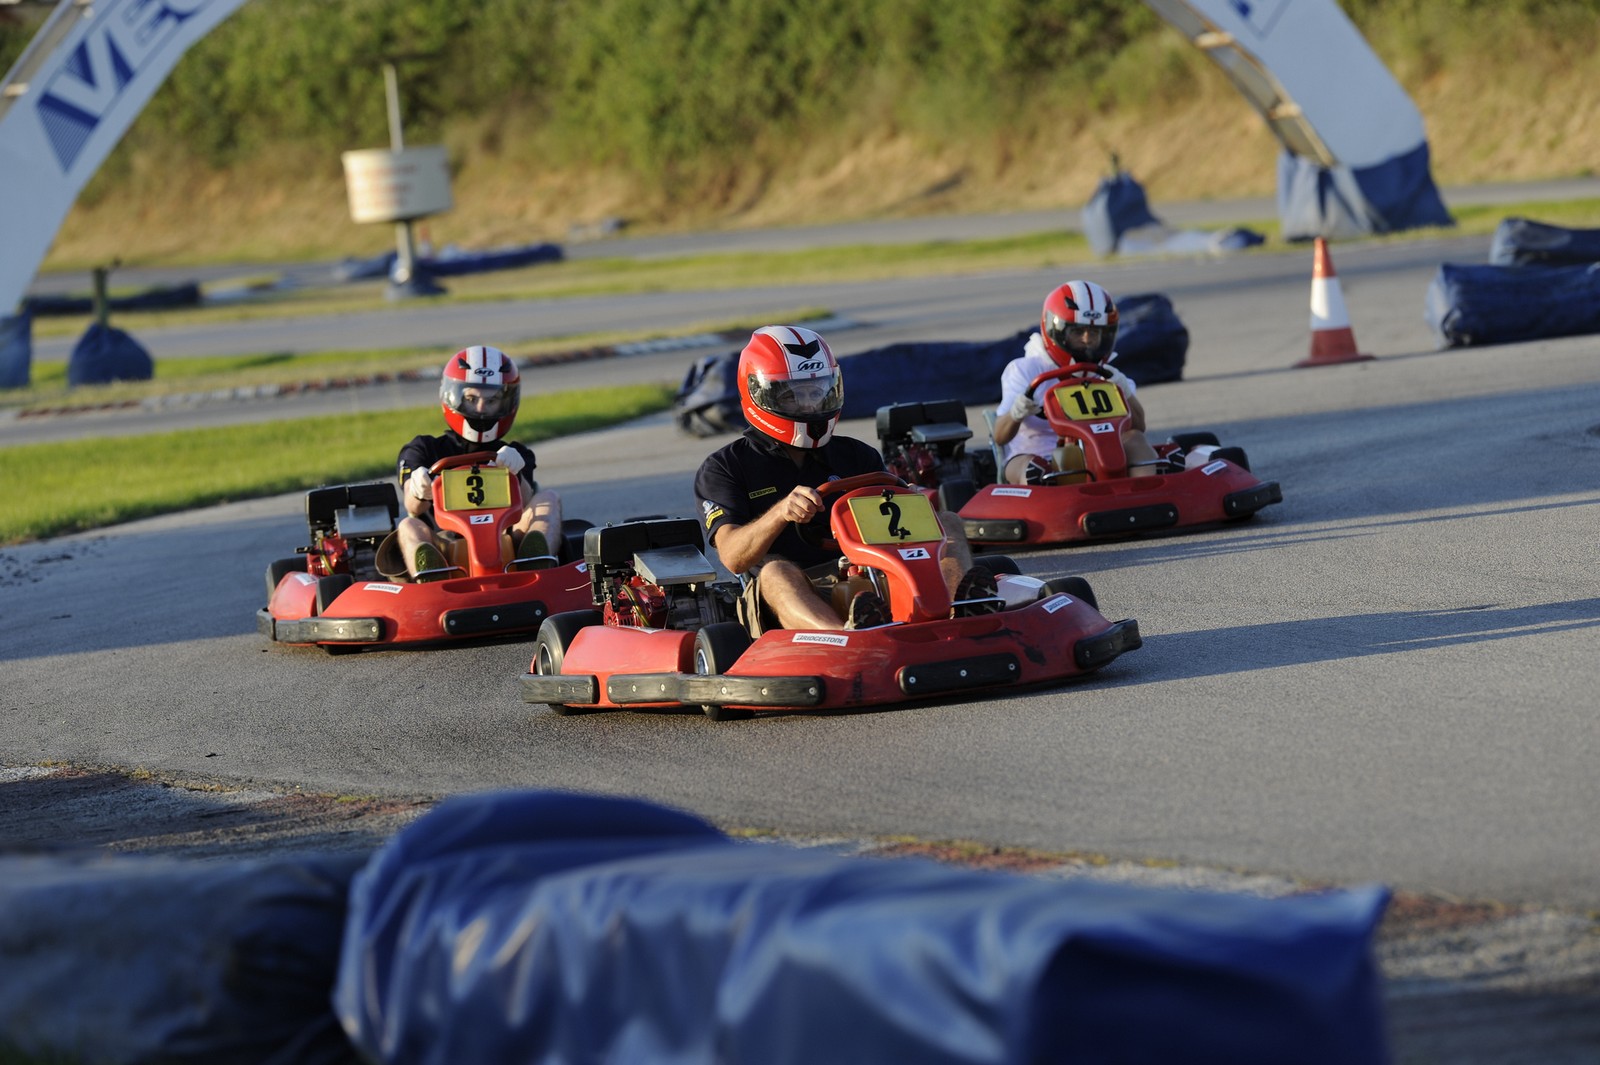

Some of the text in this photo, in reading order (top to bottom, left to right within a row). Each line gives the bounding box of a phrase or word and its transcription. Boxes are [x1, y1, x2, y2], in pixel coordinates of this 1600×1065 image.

[798, 361, 823, 373] MT
[1070, 389, 1113, 415] 10
[466, 475, 485, 505] 3
[879, 501, 911, 538] 2
